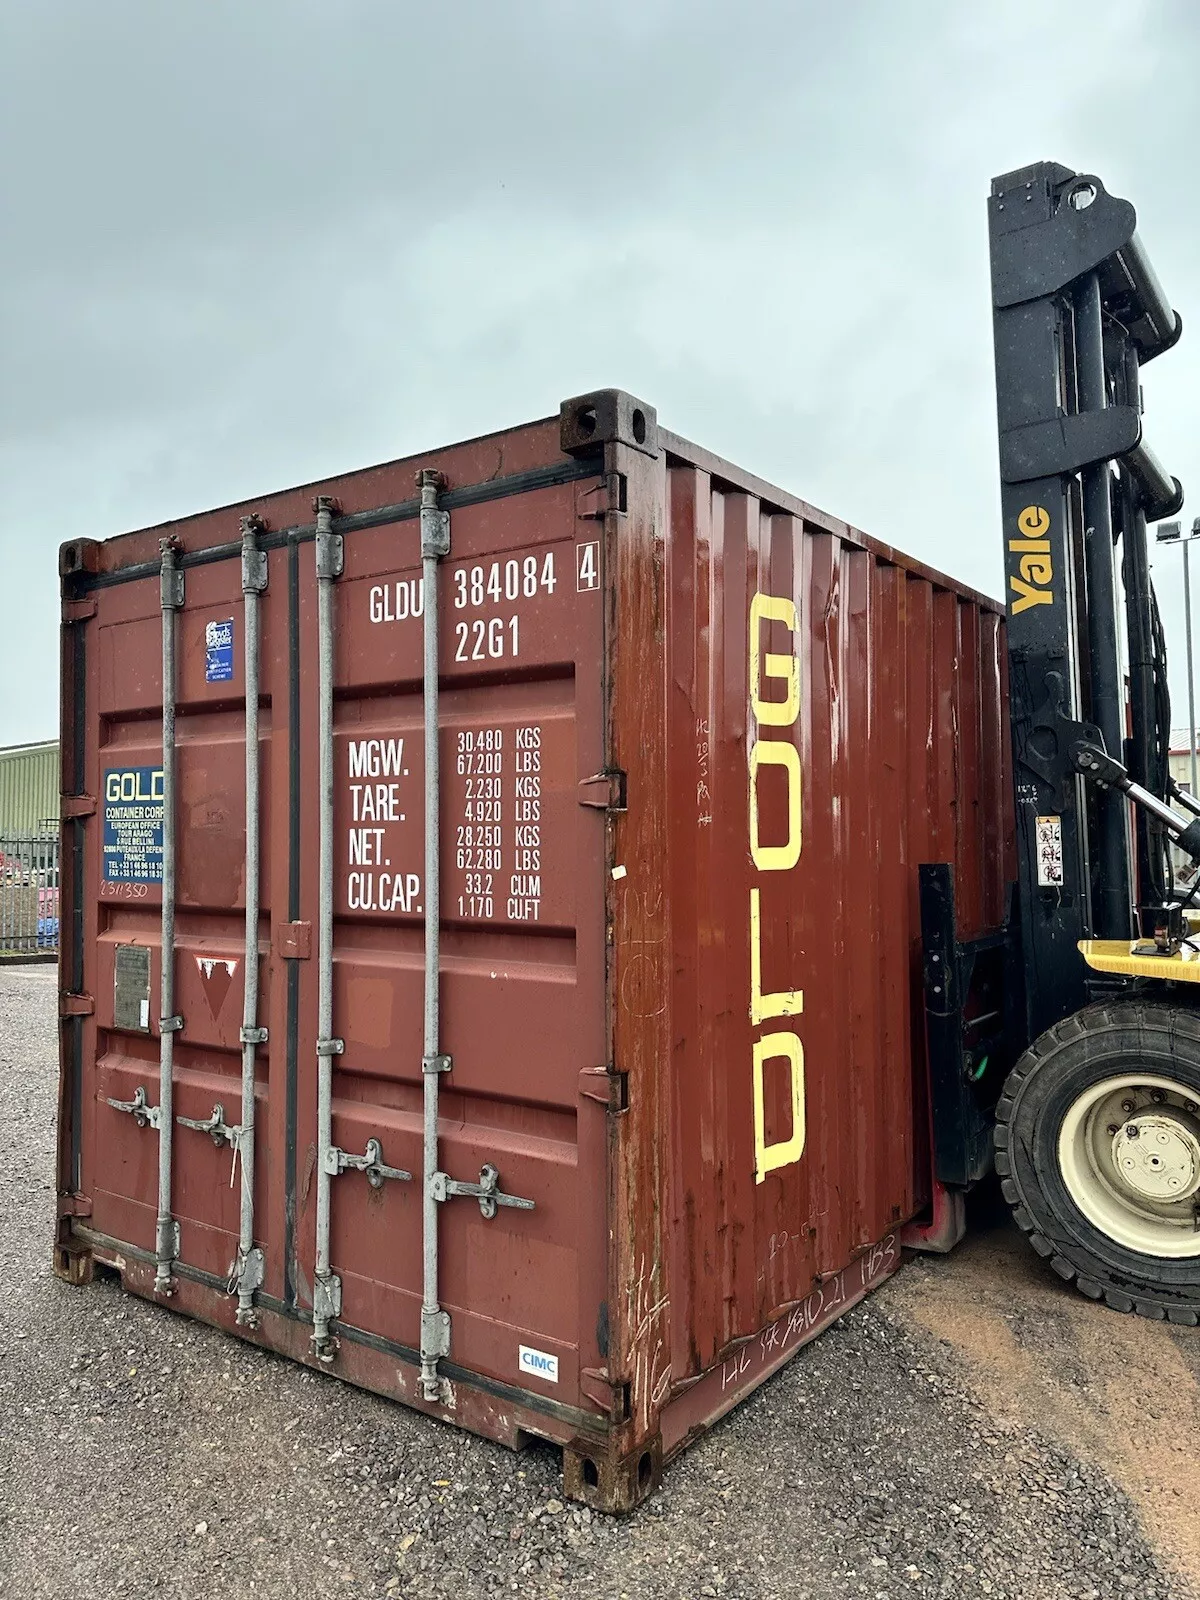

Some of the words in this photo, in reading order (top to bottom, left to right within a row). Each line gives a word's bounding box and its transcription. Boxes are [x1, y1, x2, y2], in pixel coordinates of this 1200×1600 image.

[1008, 505, 1053, 616] Yale
[369, 578, 424, 623] GLDU
[454, 552, 557, 608] 384084
[579, 544, 597, 588] 4
[454, 615, 519, 662] 22G1
[516, 727, 541, 749] KGS
[348, 738, 409, 778] MGW.
[515, 751, 541, 773] LBS
[515, 776, 541, 798] KGS
[106, 806, 144, 819] CONTAINER
[349, 783, 406, 822] TARE.
[515, 800, 540, 822] LBS
[111, 821, 139, 830] EUROPEAN
[139, 821, 160, 830] OFFICE
[117, 829, 132, 838] TOUR
[132, 829, 153, 838] ARAGO
[515, 825, 541, 847] KGS
[120, 838, 131, 846] RUE
[131, 838, 155, 846] BELLINI
[348, 828, 391, 866] NET.
[108, 861, 119, 869] TEL
[124, 854, 146, 862] FRANCE
[515, 849, 541, 871] LBS
[108, 869, 119, 877] FAX
[347, 872, 423, 913] CU.CAP.
[465, 873, 493, 895] 33.2
[510, 874, 541, 897] CU.M
[749, 590, 805, 1186] GOLD
[506, 897, 541, 920] CU.FT
[522, 1352, 556, 1373] CIMC
